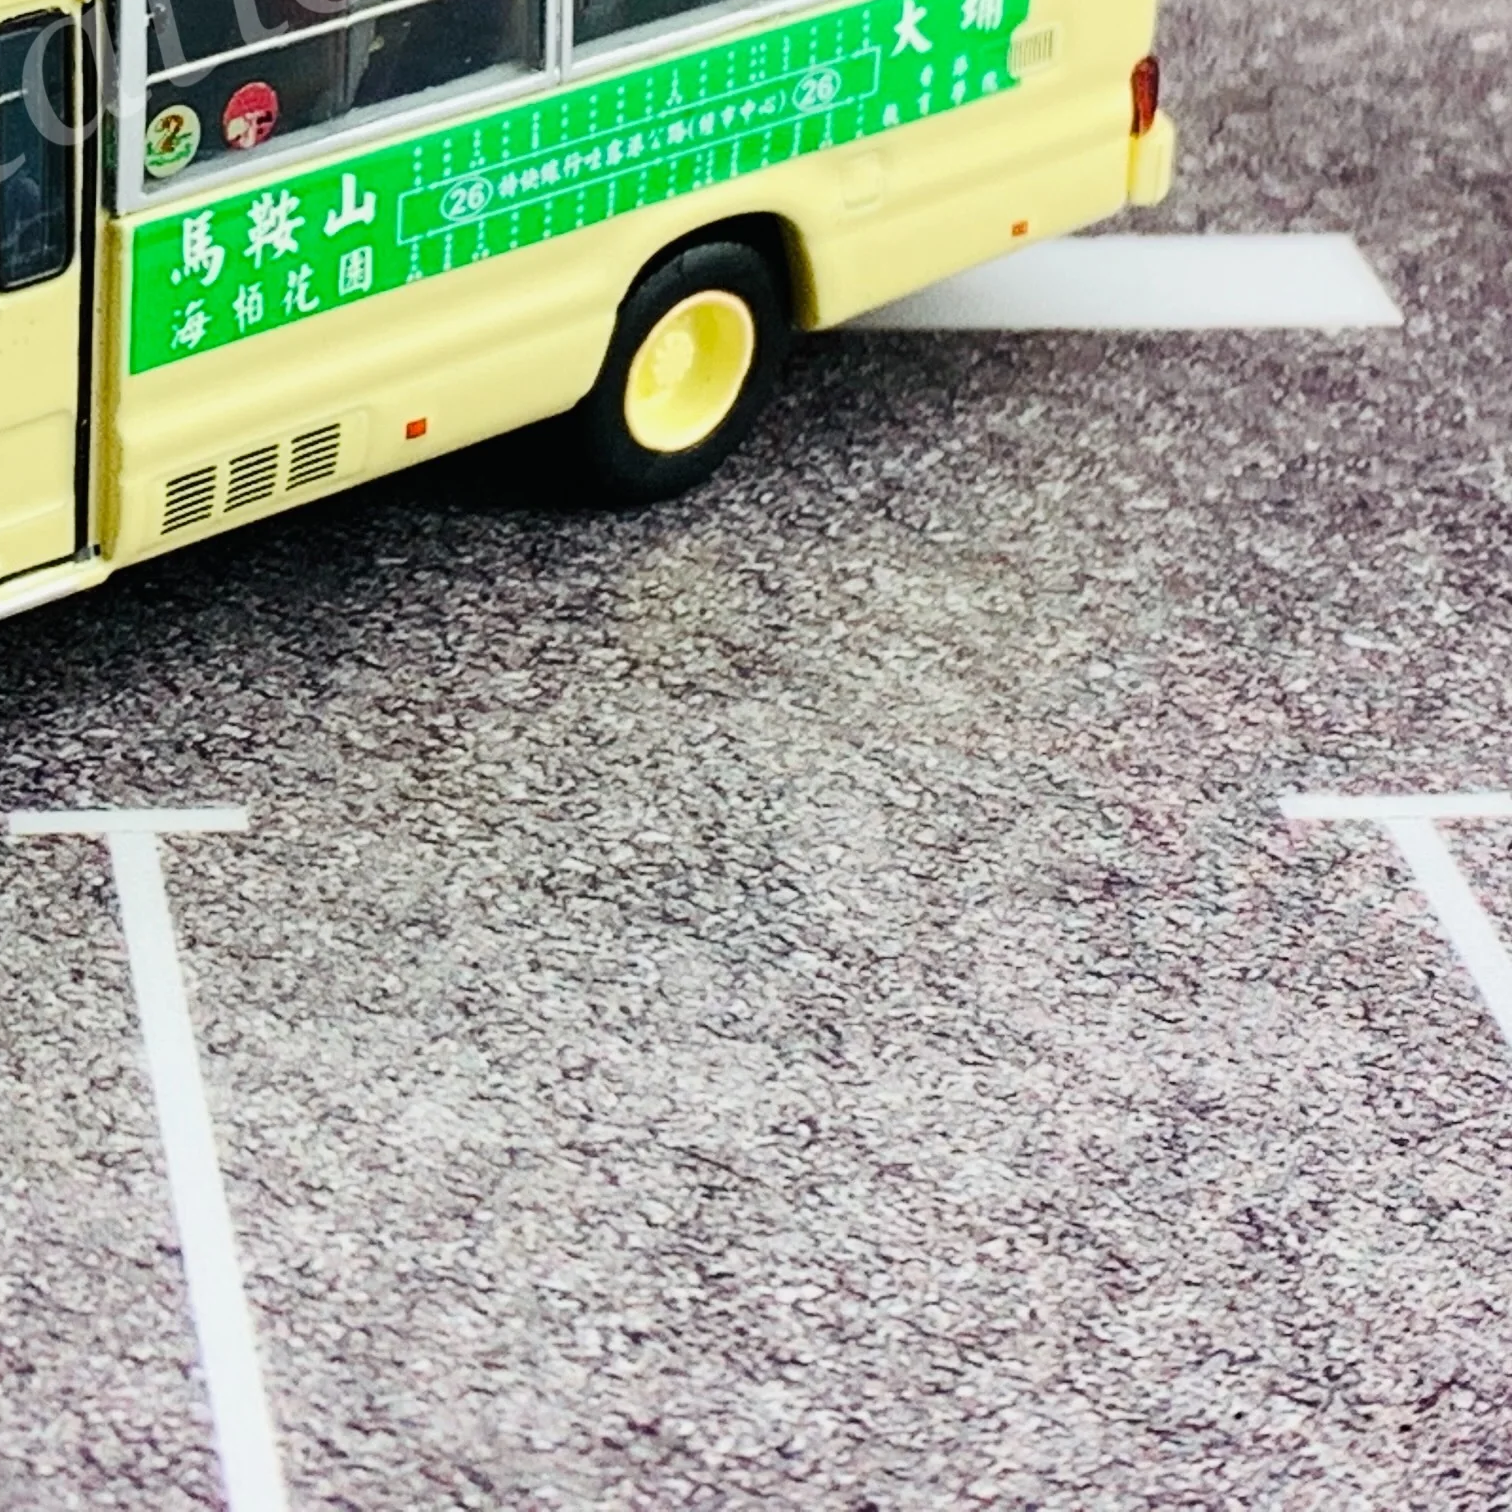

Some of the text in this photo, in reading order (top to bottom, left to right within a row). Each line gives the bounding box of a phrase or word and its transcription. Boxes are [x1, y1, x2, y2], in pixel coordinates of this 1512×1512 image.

[449, 185, 485, 218] 26
[802, 72, 834, 106] 26
[171, 172, 376, 287] 馬鞍山
